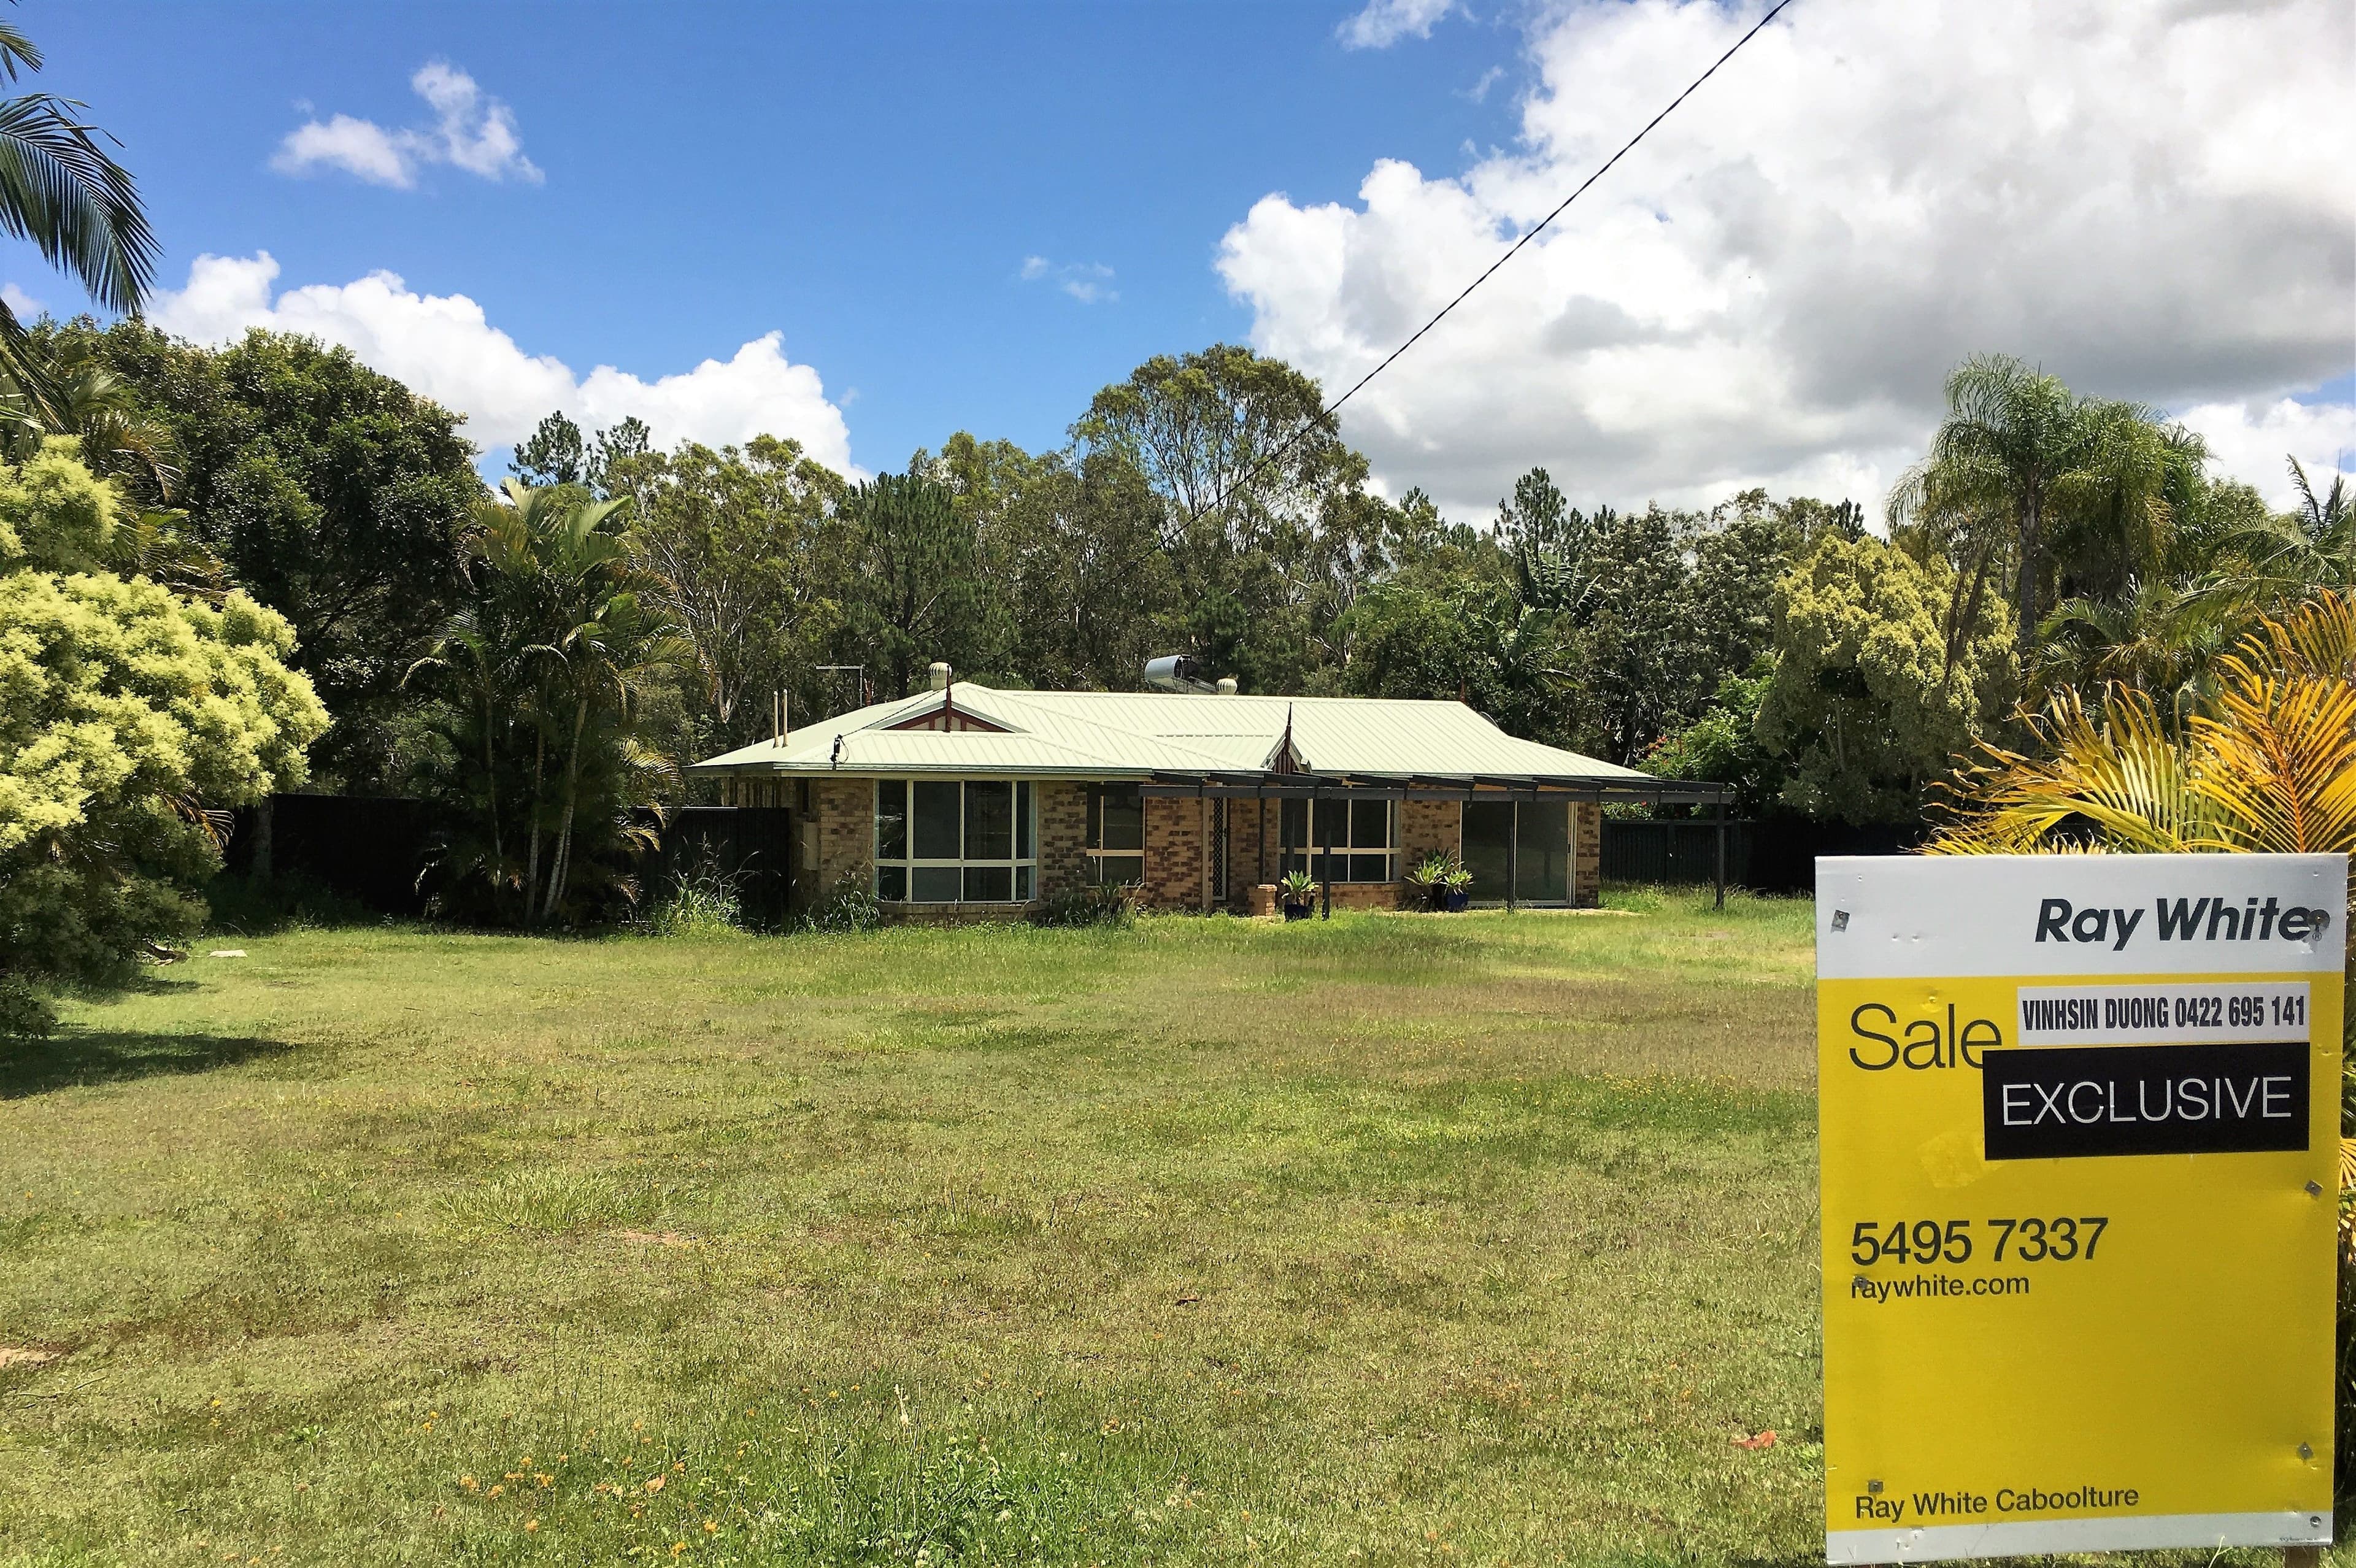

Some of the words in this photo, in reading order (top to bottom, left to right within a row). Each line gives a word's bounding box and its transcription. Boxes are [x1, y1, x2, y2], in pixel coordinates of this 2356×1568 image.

[2035, 897, 2144, 951] Ray
[2157, 896, 2311, 941] White
[1849, 1003, 2002, 1070] Sale
[2022, 998, 2098, 1031] VINHSIN
[2105, 997, 2168, 1029] DUONG
[2175, 996, 2222, 1028] 0422
[2228, 996, 2264, 1028] 695
[2271, 994, 2305, 1026] 141
[2003, 1076, 2292, 1126] EXCLUSIVE
[1851, 1220, 1972, 1266] 5495
[1988, 1217, 2109, 1262] 7337
[1851, 1274, 2030, 1304] raywhite.com
[1855, 1496, 1904, 1523] Ray
[1912, 1491, 1987, 1515] White
[1996, 1486, 2139, 1512] Caboolture
